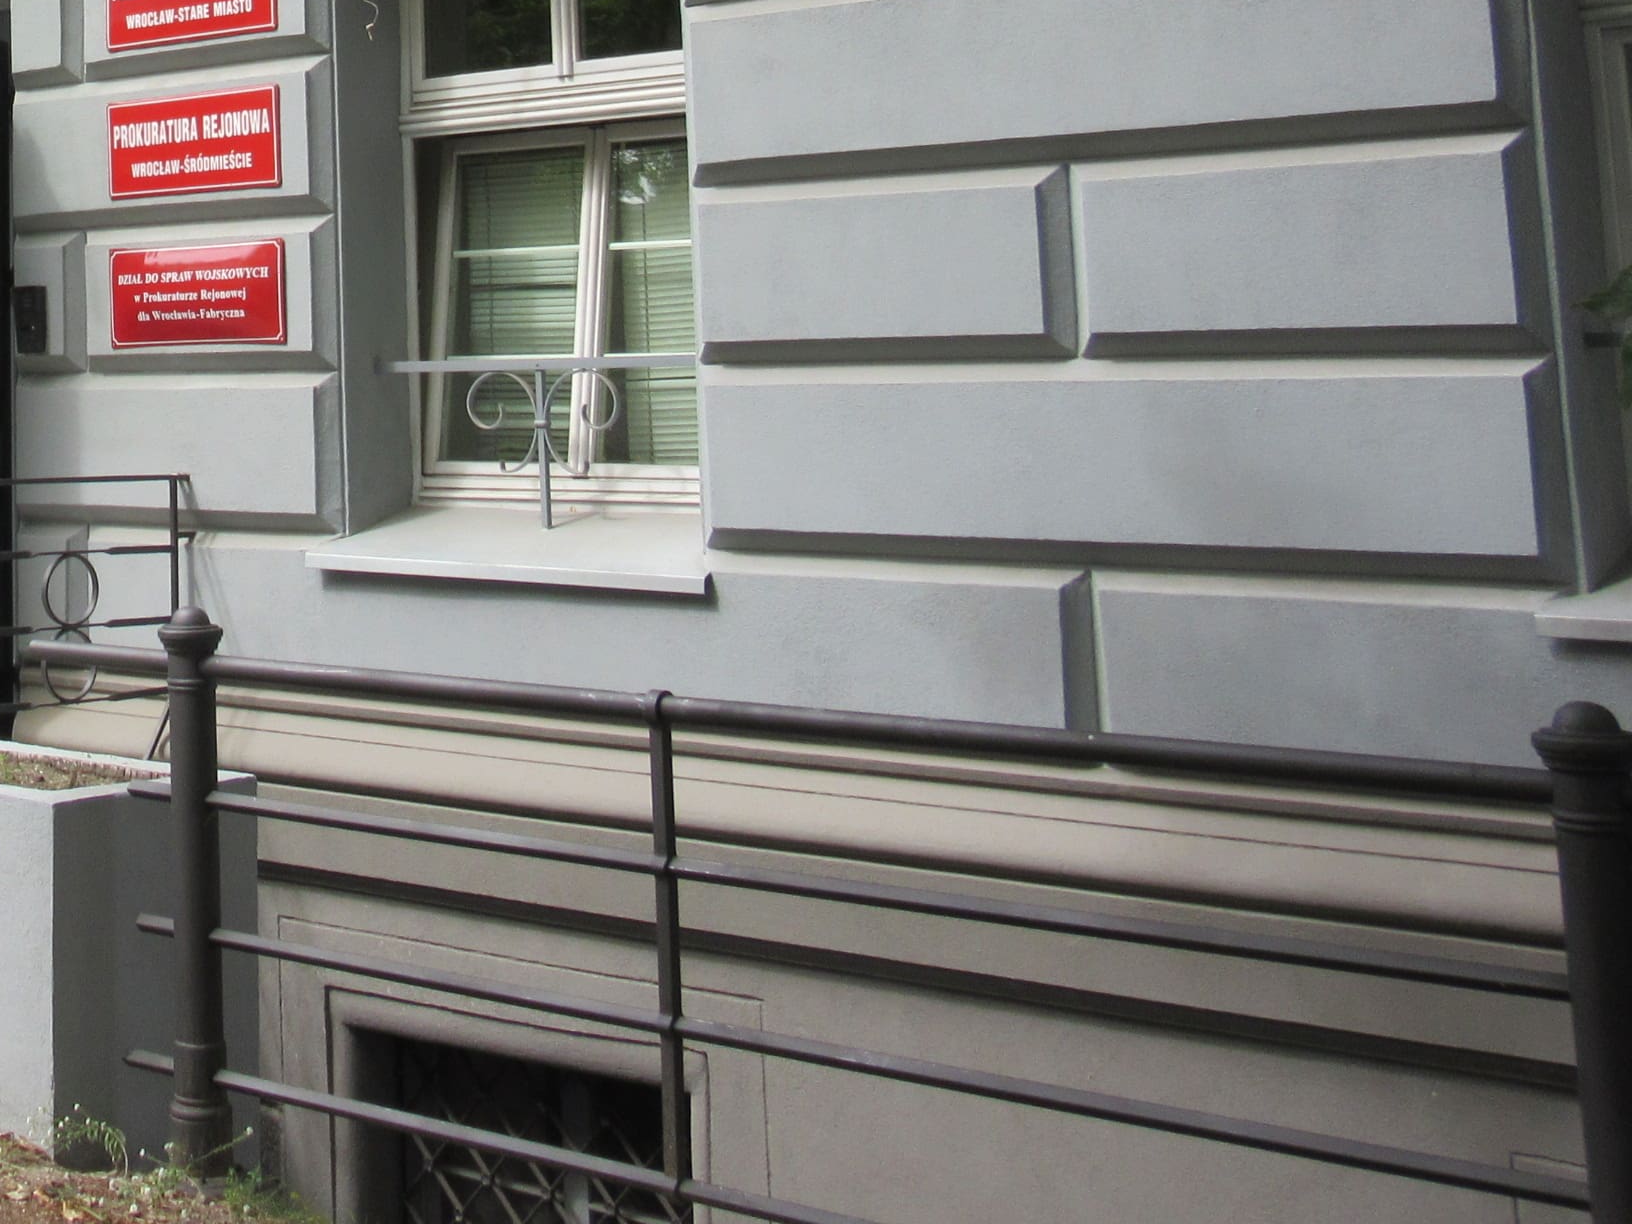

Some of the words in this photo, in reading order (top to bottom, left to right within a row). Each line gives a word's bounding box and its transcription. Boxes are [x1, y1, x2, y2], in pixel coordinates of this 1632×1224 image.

[126, 3, 209, 29] WROCŁAW-STARE
[113, 116, 198, 150] PROKURATURA
[203, 108, 270, 140] REJONOWA
[131, 150, 253, 178] WROCŁAW-ŚRÓDMIEŚCIE
[145, 272, 159, 284] DO
[160, 270, 194, 283] SPRAW
[195, 266, 269, 281] WOJSKOWYCH
[133, 294, 141, 303] w
[143, 291, 198, 303] Prokuraturze
[200, 287, 246, 302] Rejonowej
[137, 311, 151, 322] dla
